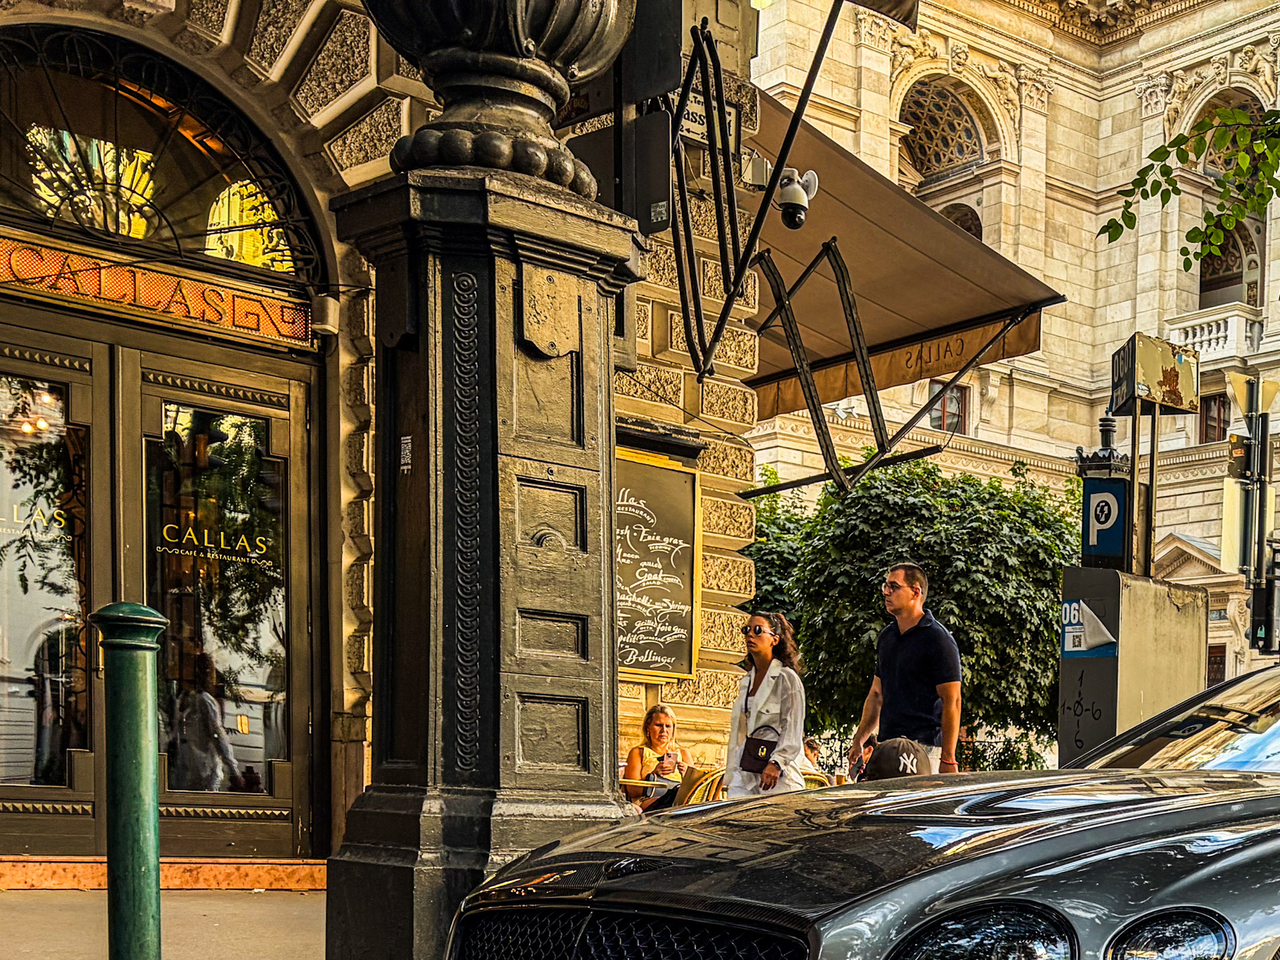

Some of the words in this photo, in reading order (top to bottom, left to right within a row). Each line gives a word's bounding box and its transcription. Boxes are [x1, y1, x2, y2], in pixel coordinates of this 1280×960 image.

[10, 245, 226, 325] CALLAS
[1113, 339, 1133, 383] 0601
[616, 487, 647, 507] llas
[616, 505, 655, 524] ESTAURANT
[1089, 492, 1119, 546] P
[163, 524, 267, 554] CALLAS
[207, 552, 250, 564] RESTAURANT
[898, 752, 918, 774] NY
